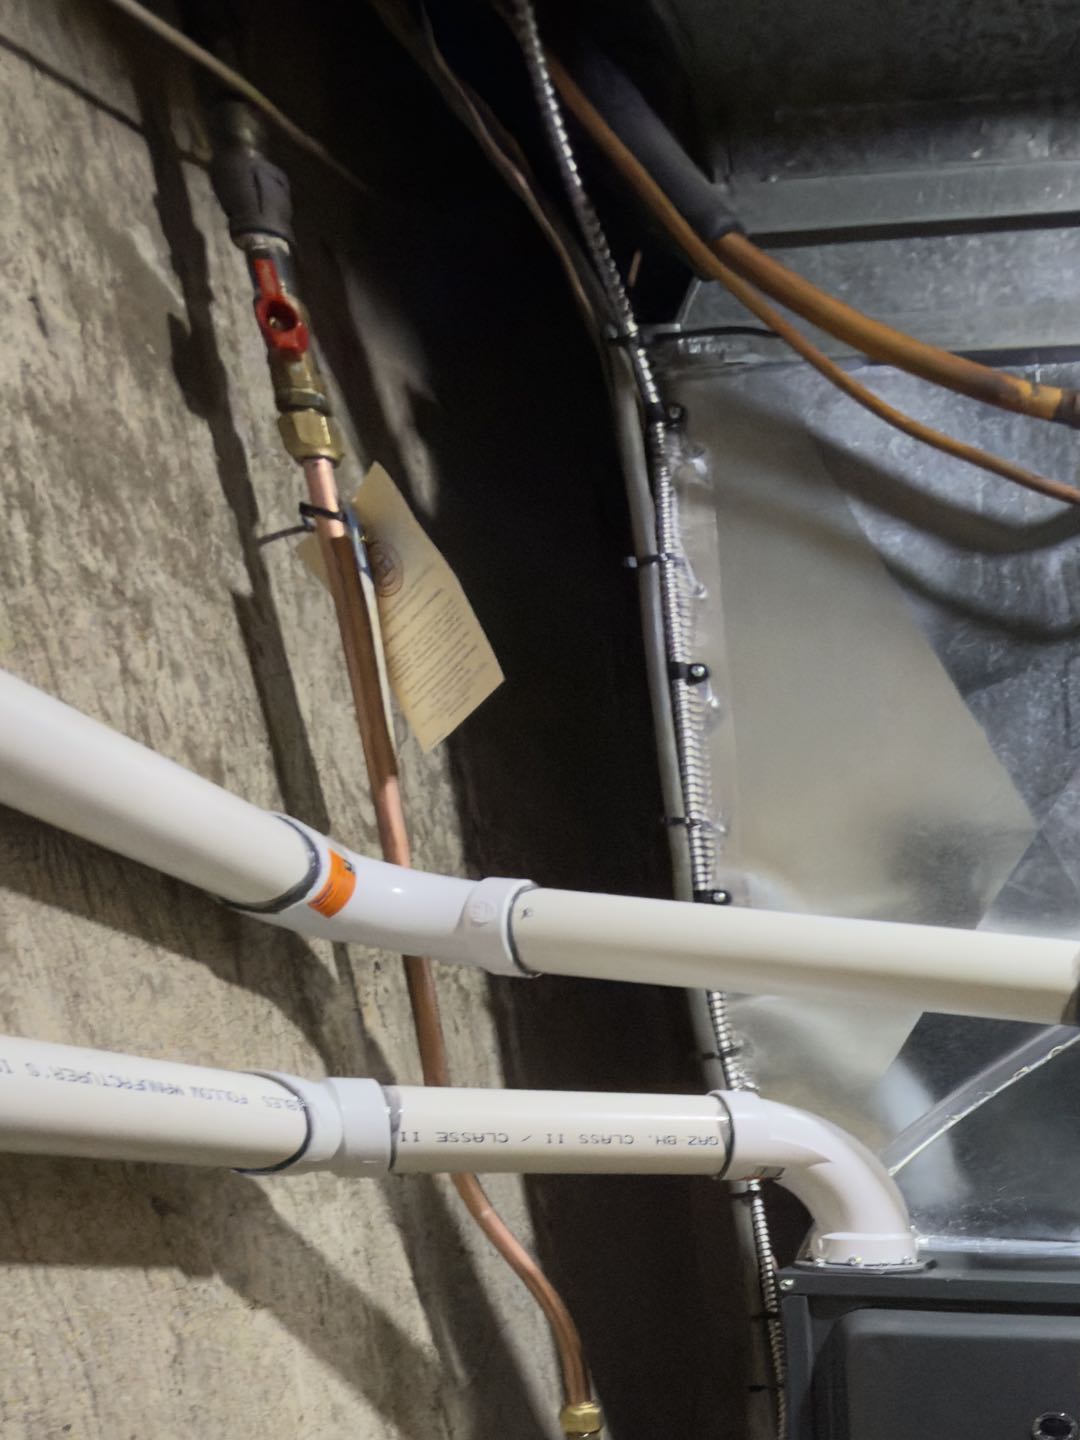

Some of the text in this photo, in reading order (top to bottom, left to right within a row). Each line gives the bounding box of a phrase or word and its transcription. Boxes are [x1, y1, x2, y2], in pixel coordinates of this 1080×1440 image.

[189, 1086, 249, 1105] FOLLOW
[400, 1130, 420, 1143] II
[435, 1131, 510, 1144] CLASSE
[546, 1133, 565, 1145] II
[579, 1133, 635, 1145] CLASS
[686, 1135, 719, 1146] GAZ
